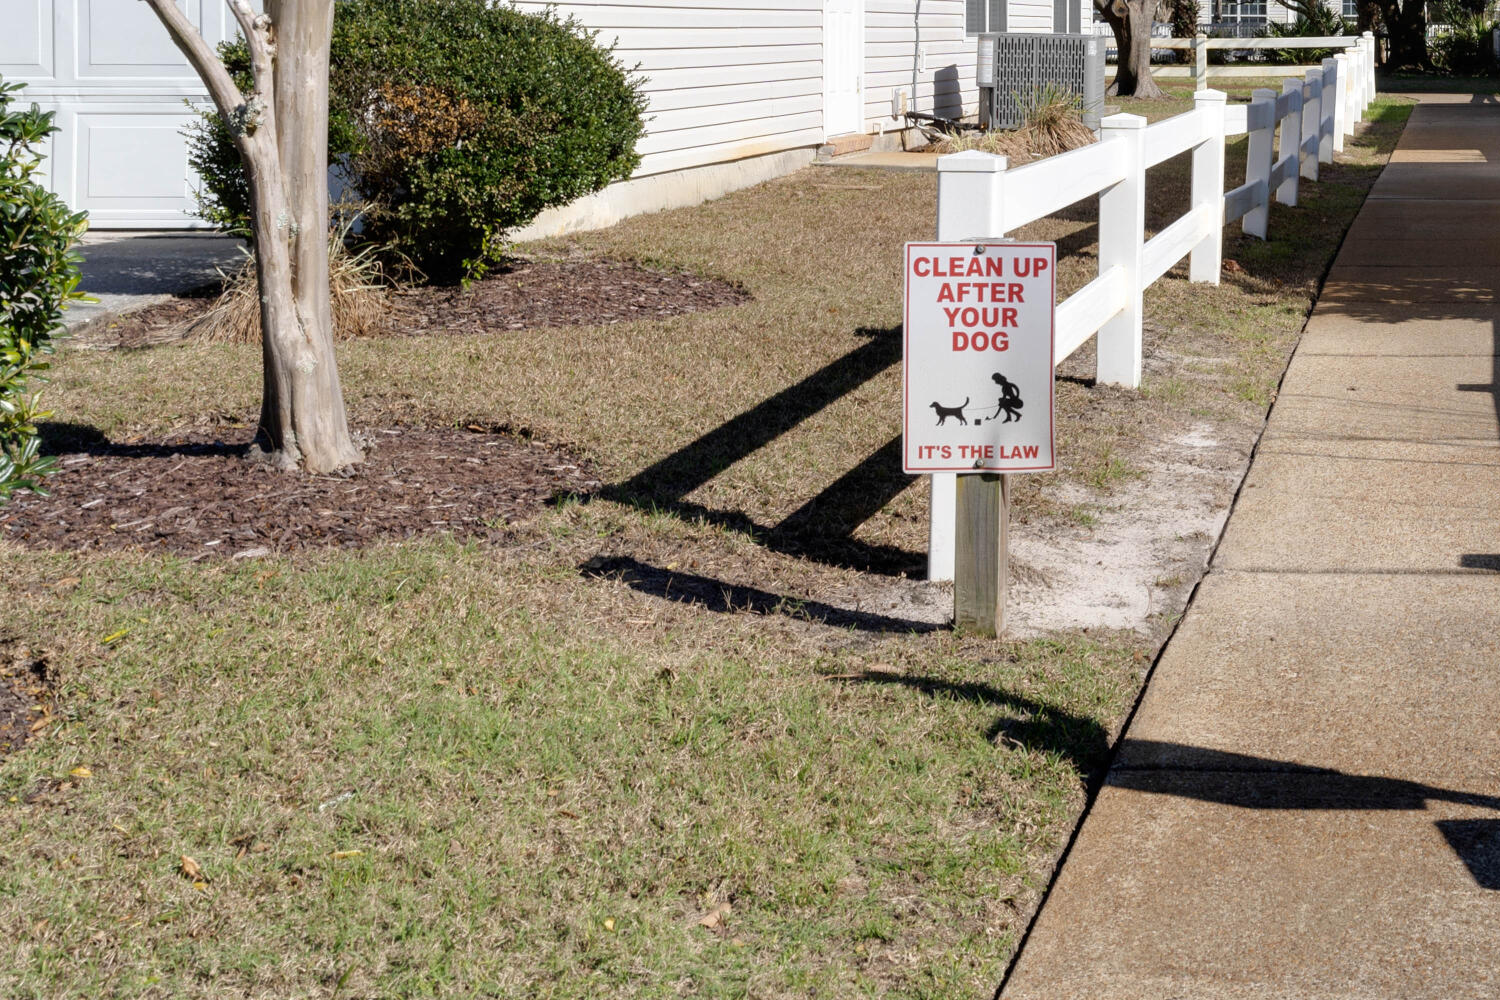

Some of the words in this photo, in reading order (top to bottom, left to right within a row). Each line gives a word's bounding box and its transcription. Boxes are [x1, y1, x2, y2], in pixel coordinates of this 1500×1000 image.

[913, 257, 1003, 277] CLEAN
[1013, 257, 1048, 278] UP
[936, 282, 1024, 303] AFTER
[943, 307, 1019, 328] YOUR
[952, 331, 1009, 352] DOG
[918, 445, 952, 459] IT'S
[958, 445, 994, 459] THE
[1000, 445, 1039, 459] LAW
